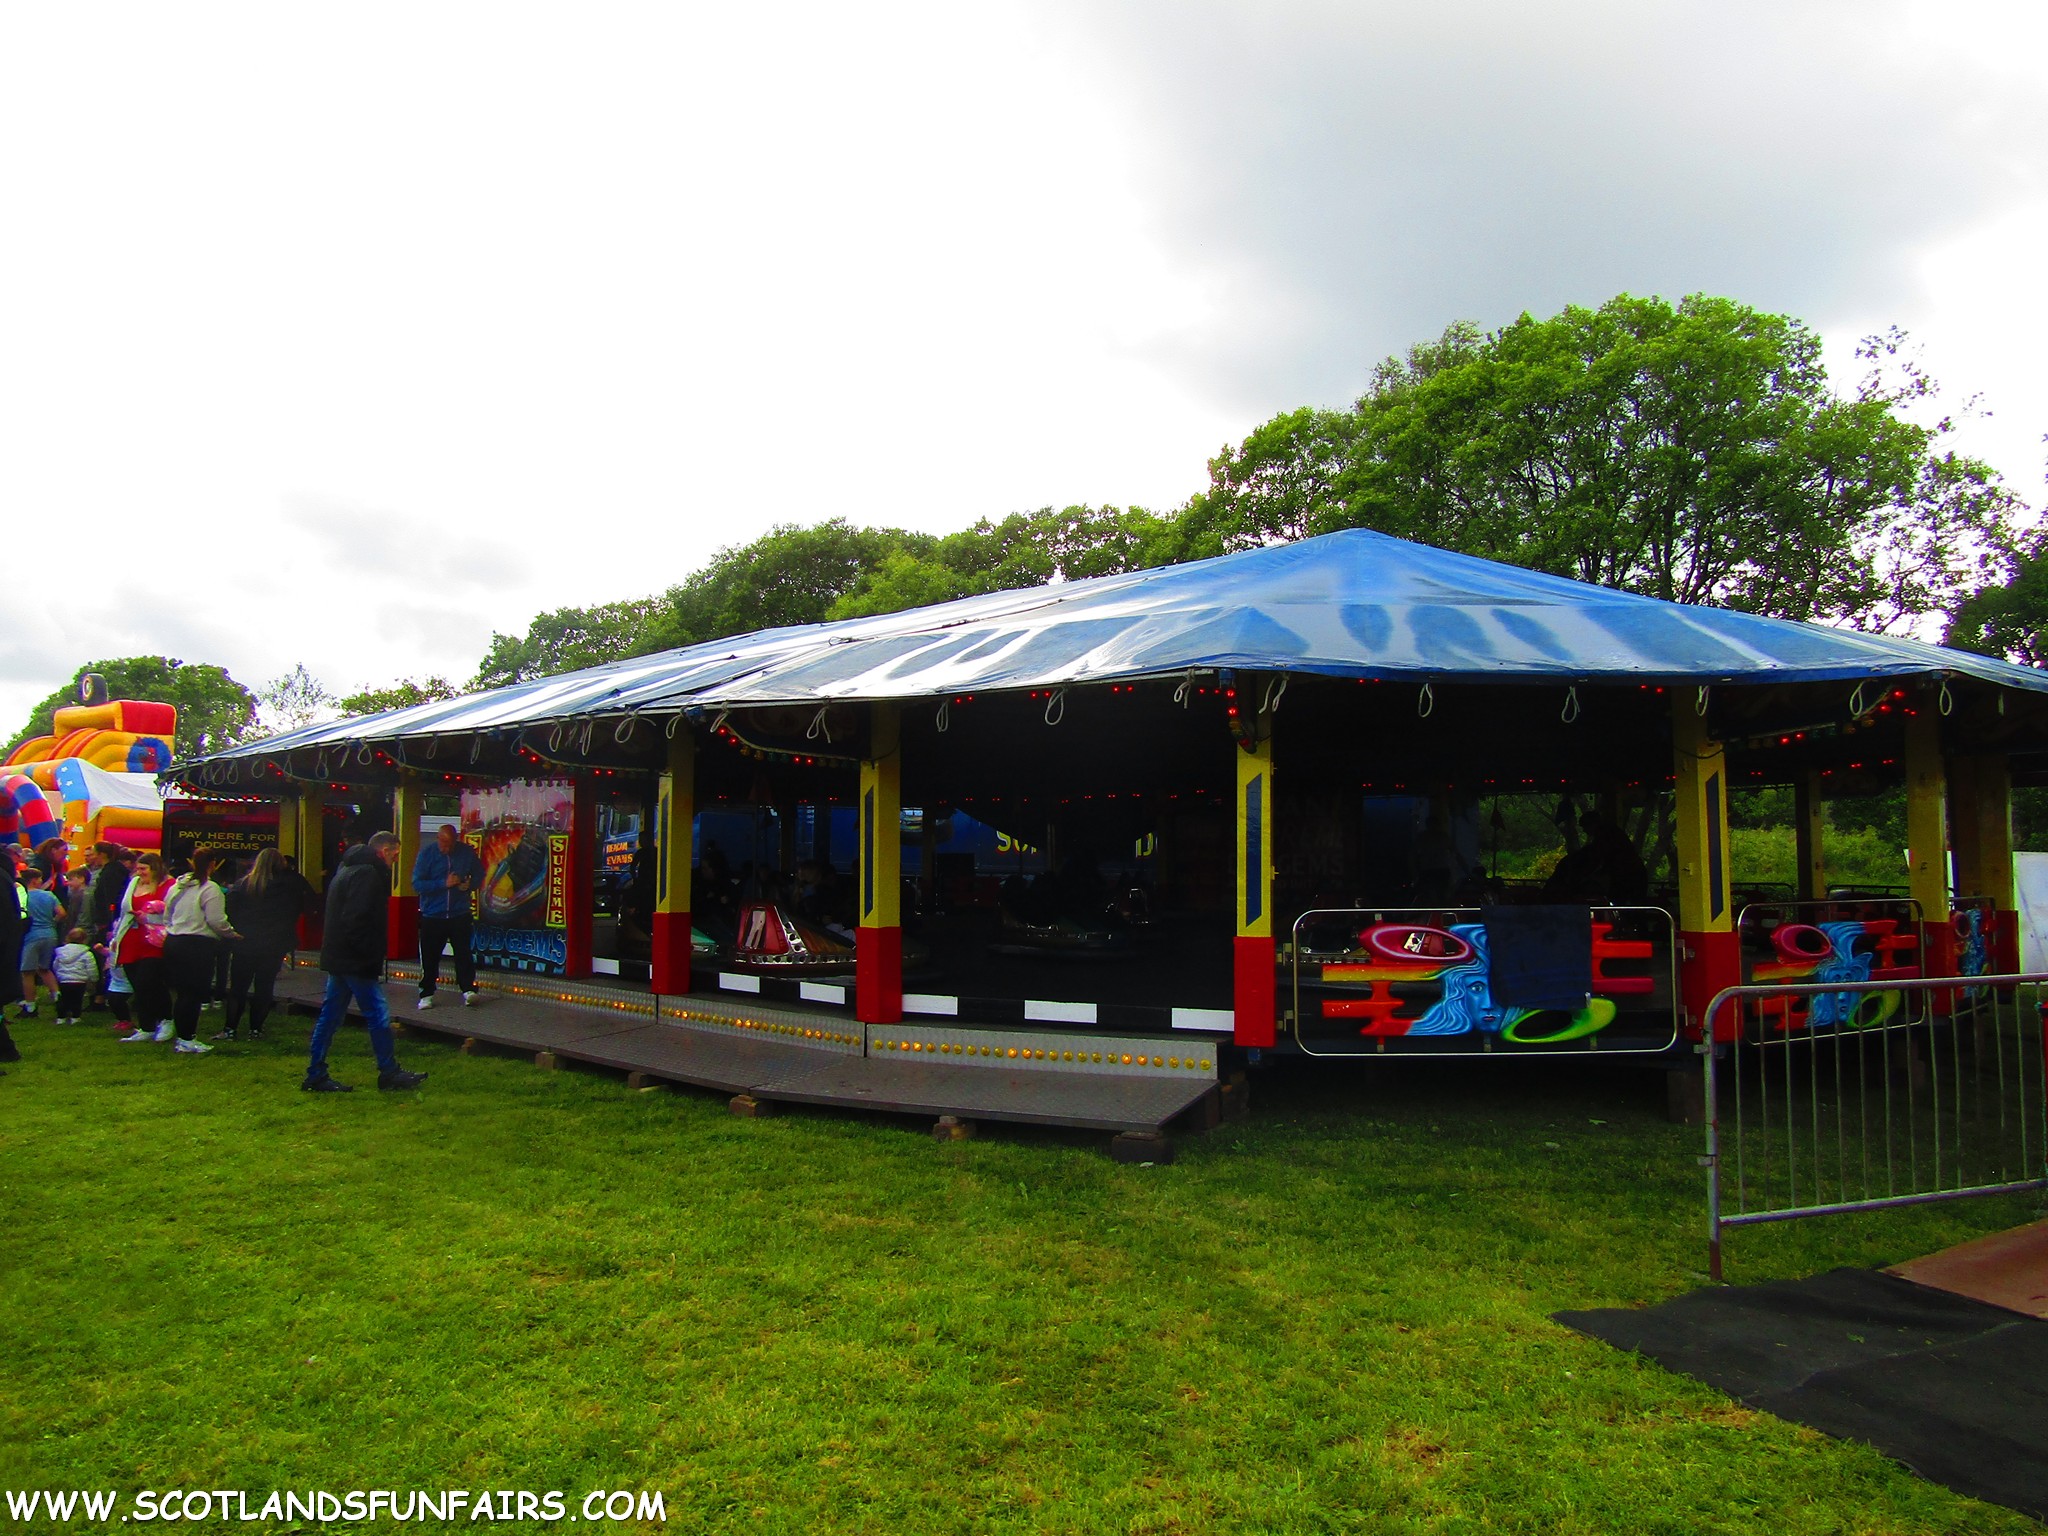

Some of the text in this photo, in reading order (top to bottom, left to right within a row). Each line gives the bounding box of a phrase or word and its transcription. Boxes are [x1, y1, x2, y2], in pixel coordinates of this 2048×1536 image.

[178, 830, 276, 842] PAY HERE FOR
[194, 840, 261, 851] DODGEMS
[606, 853, 634, 866] EVANS
[551, 838, 565, 925] SUPREME
[471, 927, 567, 966] ODGEMS
